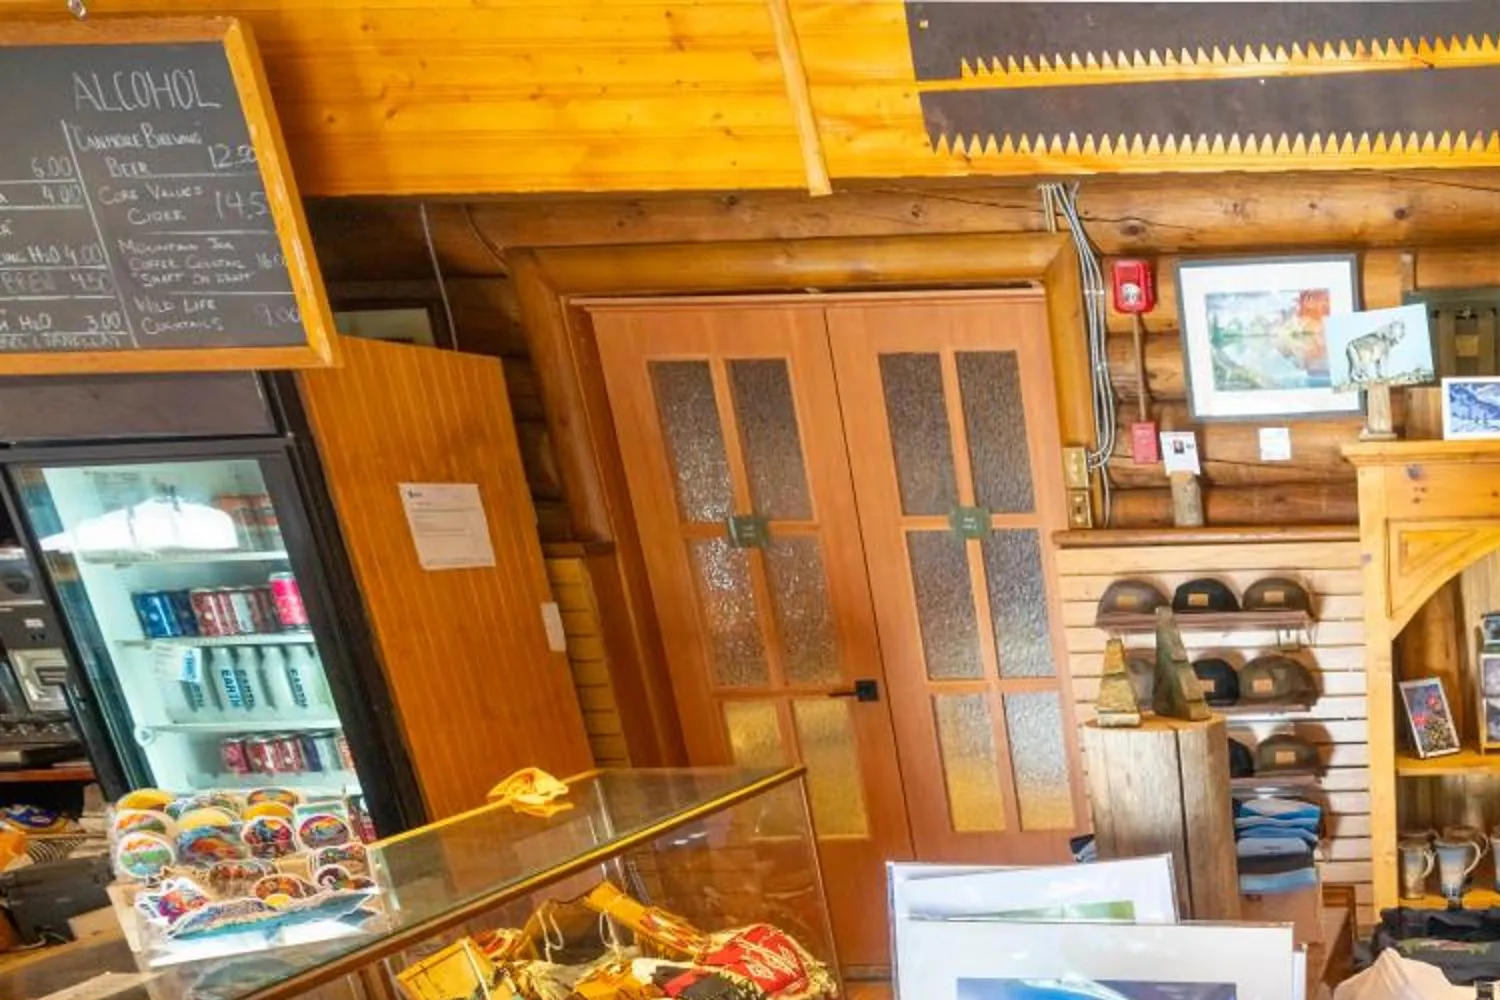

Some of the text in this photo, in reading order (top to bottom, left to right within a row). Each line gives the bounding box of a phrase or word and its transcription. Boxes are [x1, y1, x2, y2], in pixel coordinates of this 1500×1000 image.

[72, 69, 222, 112] ALCOHOL
[98, 185, 140, 205] CORE
[183, 298, 217, 313] LIFE
